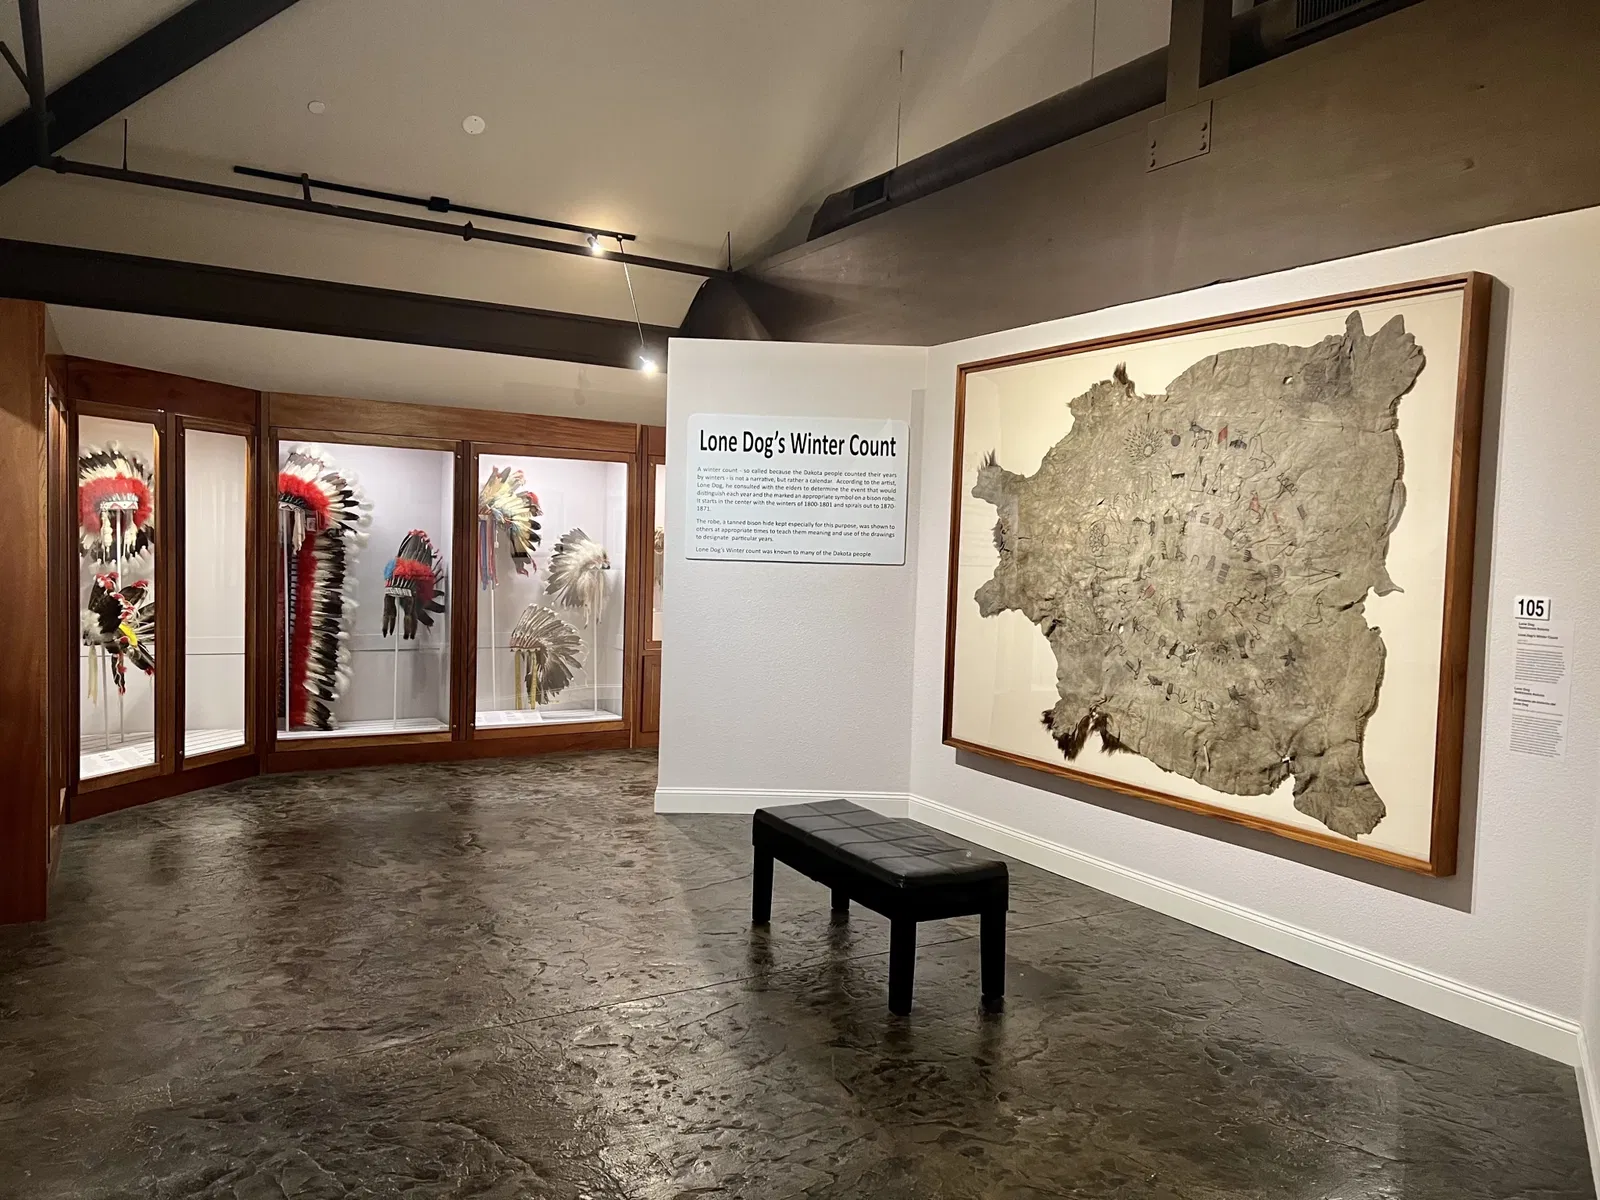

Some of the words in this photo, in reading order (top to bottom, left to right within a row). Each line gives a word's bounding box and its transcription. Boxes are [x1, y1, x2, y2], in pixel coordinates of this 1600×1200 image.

[700, 429, 737, 452] Lone
[743, 430, 785, 459] Dog’s
[790, 432, 845, 455] Winter
[849, 434, 896, 457] Count
[721, 526, 752, 534] appropriate
[1518, 599, 1544, 617] 105
